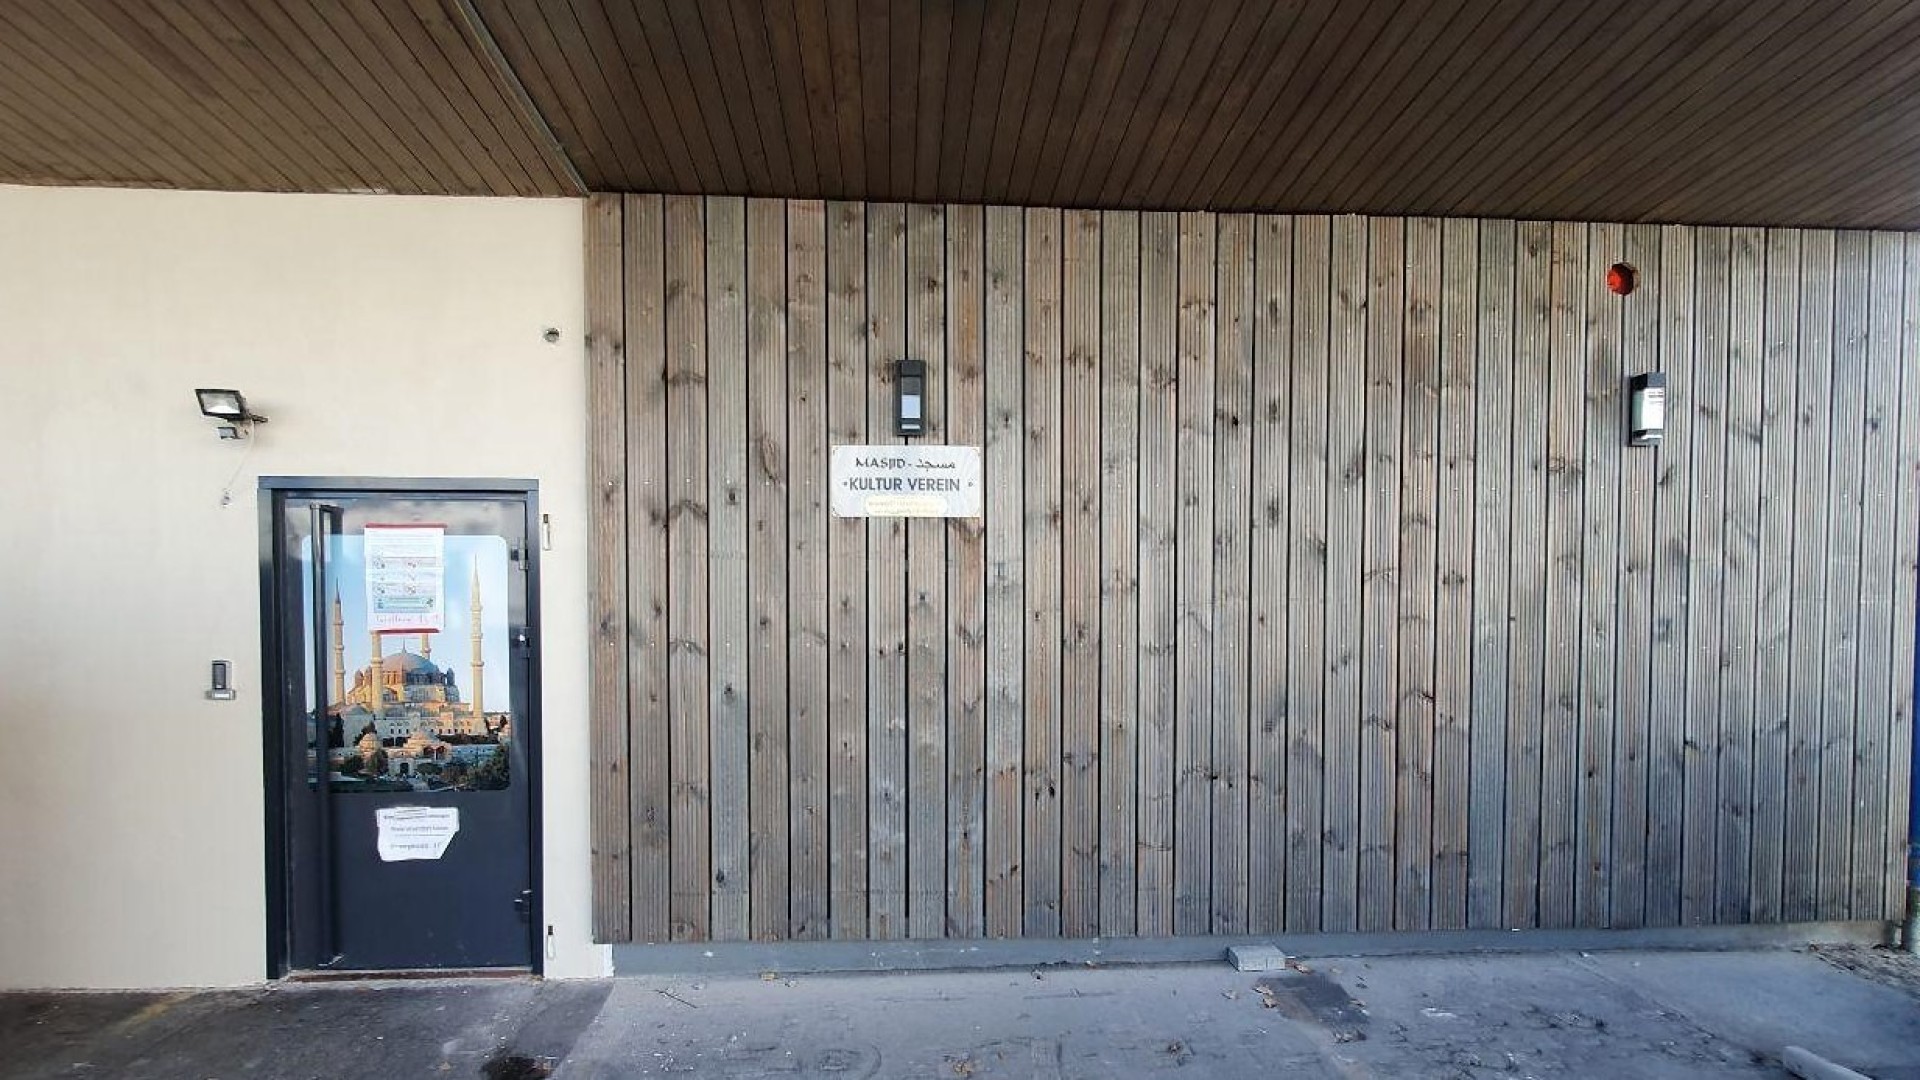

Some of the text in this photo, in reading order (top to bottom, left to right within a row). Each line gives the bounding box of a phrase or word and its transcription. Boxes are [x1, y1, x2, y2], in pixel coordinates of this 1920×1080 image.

[856, 457, 906, 470] MASJID
[849, 477, 960, 491] KULTUR VEREIN
